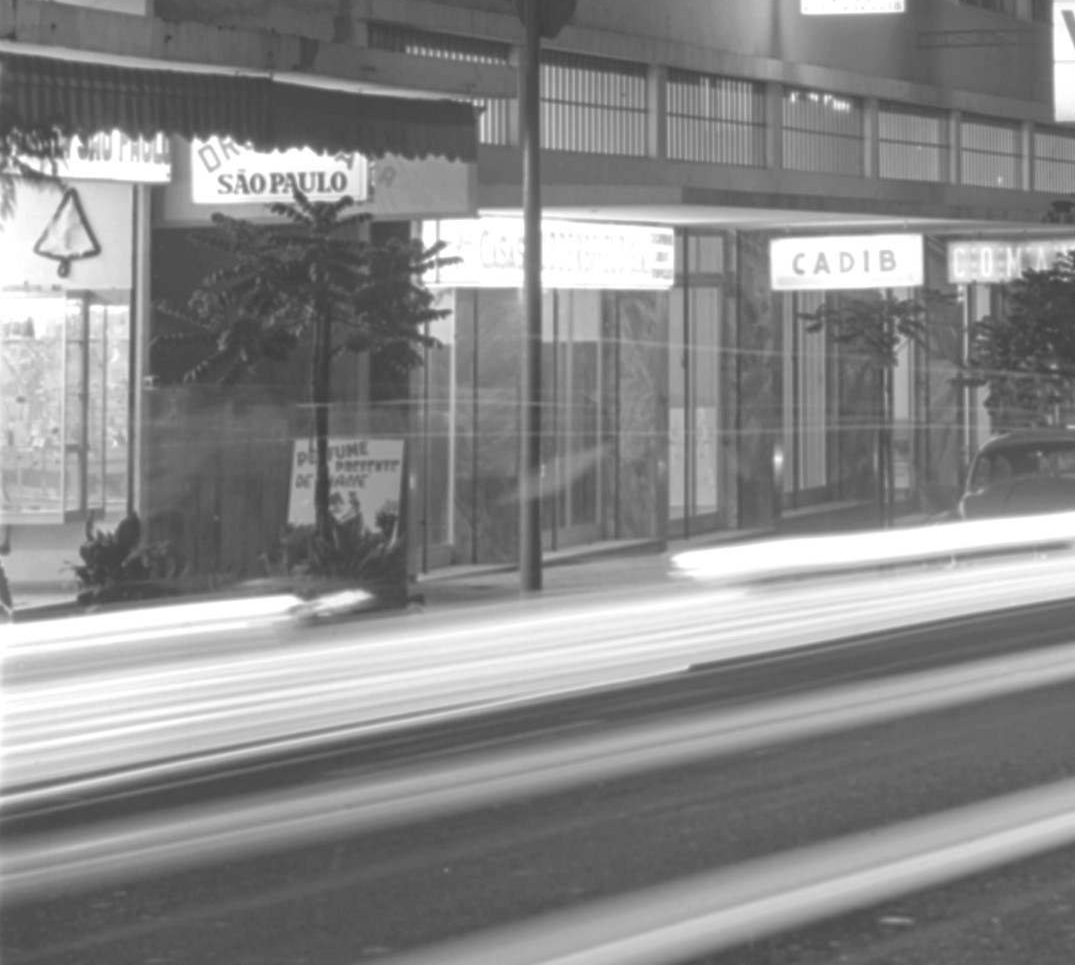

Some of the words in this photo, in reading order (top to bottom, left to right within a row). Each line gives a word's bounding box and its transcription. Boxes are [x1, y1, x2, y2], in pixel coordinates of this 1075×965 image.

[217, 169, 266, 195] SÃO
[269, 171, 348, 194] PAULO
[792, 249, 897, 276] CADIB
